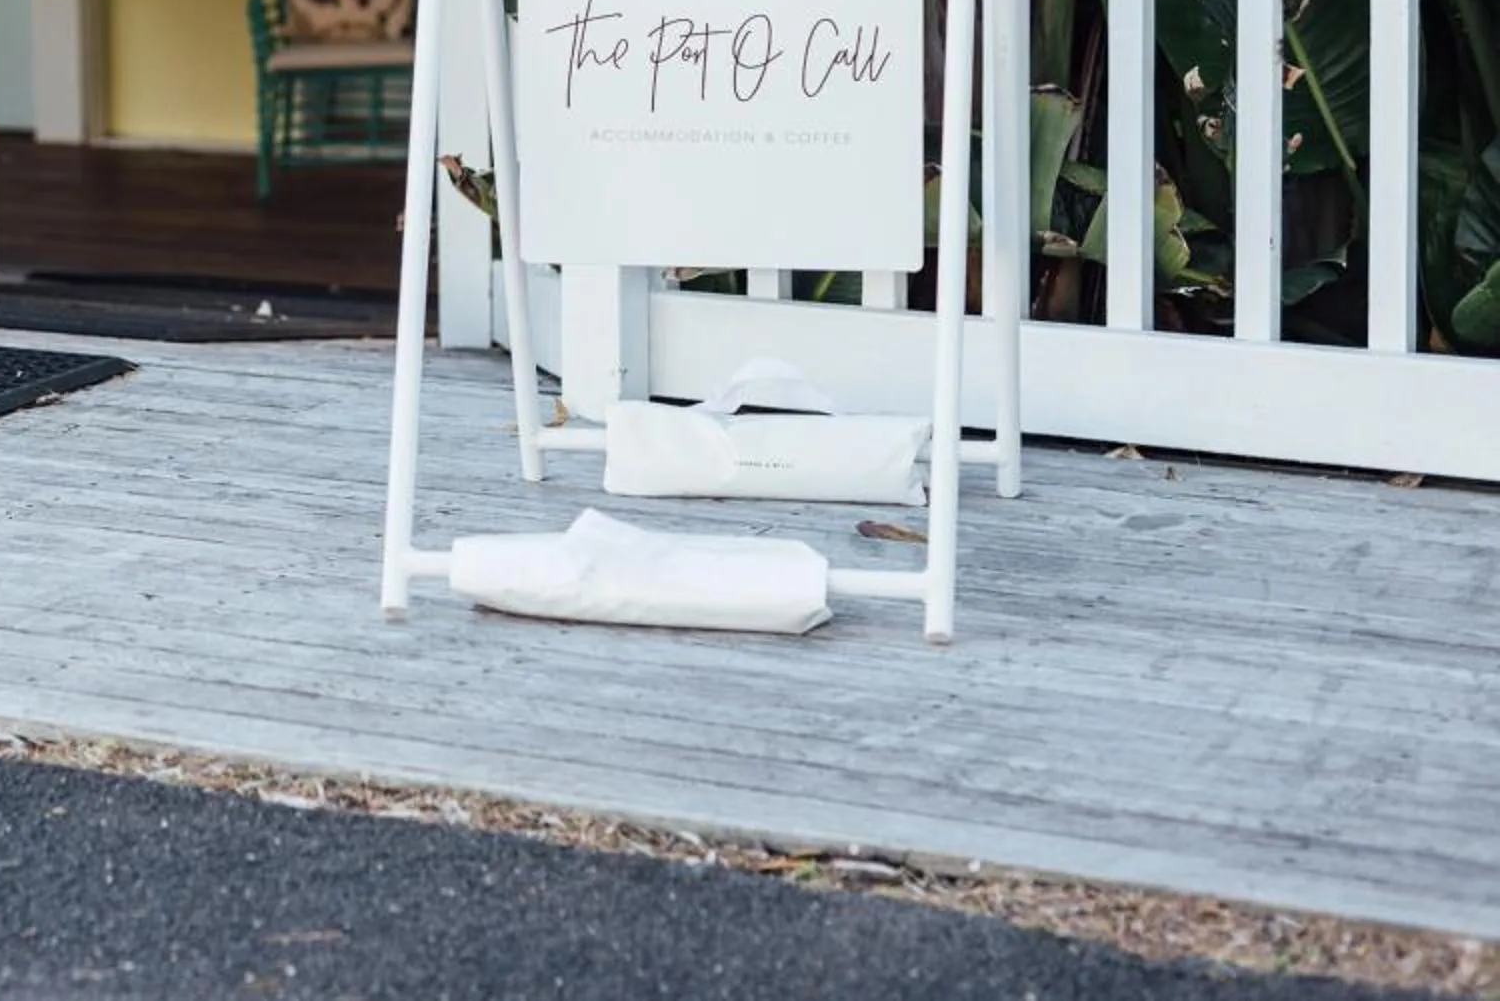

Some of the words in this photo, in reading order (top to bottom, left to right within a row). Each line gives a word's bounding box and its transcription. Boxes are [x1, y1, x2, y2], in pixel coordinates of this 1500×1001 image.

[647, 14, 732, 113] Port
[731, 13, 783, 102] O
[801, 17, 891, 99] Call
[589, 128, 755, 145] ACCOMMODATION
[763, 130, 776, 145] &
[784, 130, 853, 146] COFFEE
